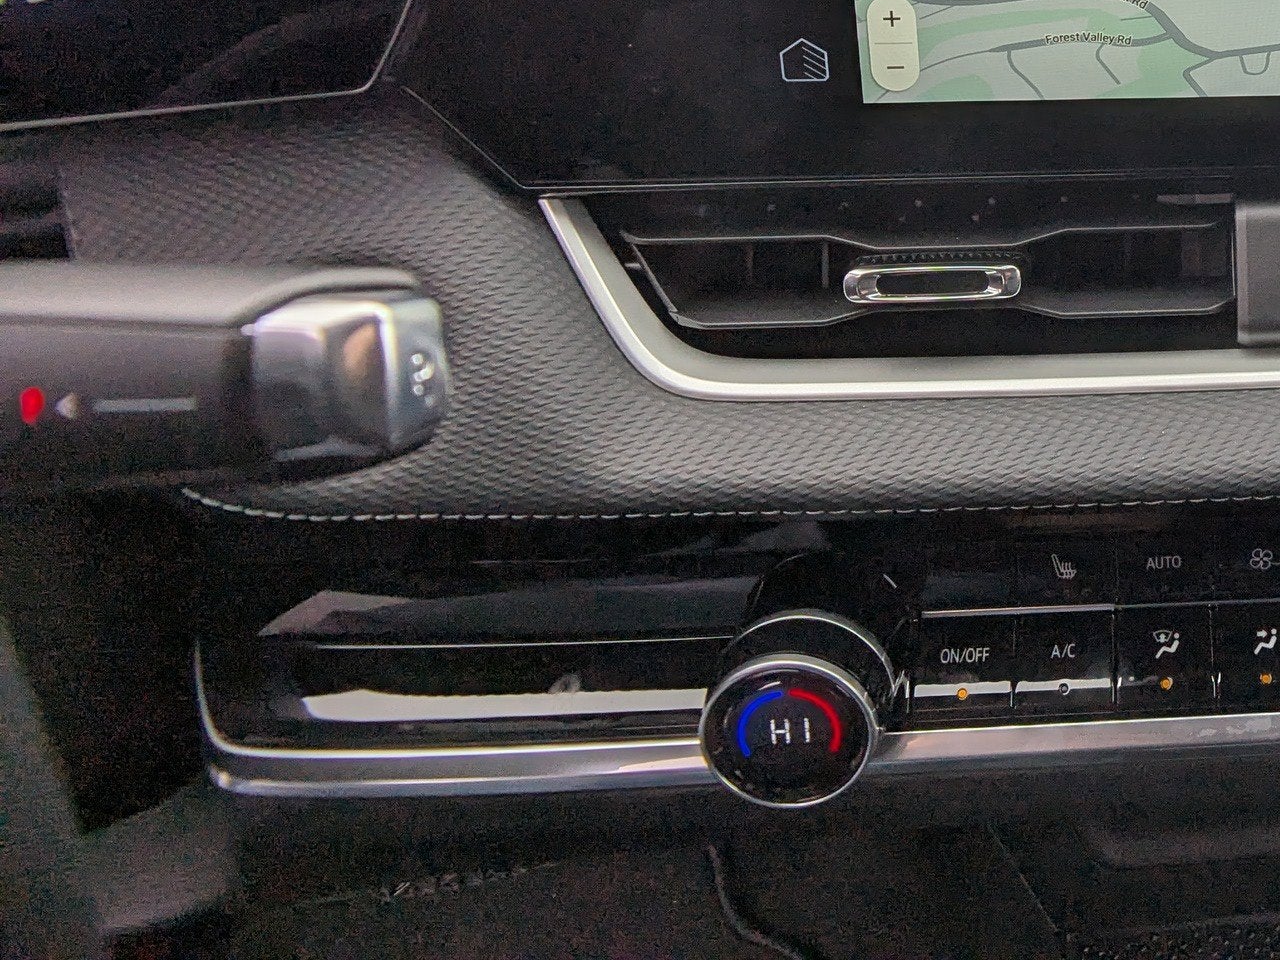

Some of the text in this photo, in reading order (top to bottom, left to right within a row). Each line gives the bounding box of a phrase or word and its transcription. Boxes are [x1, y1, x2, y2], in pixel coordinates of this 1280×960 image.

[1045, 32, 1133, 45] Forest Valley Rd
[1146, 555, 1182, 570] AUTO
[940, 647, 990, 664] ON/OFF
[1051, 643, 1076, 659] A/C
[770, 717, 810, 744] HI
